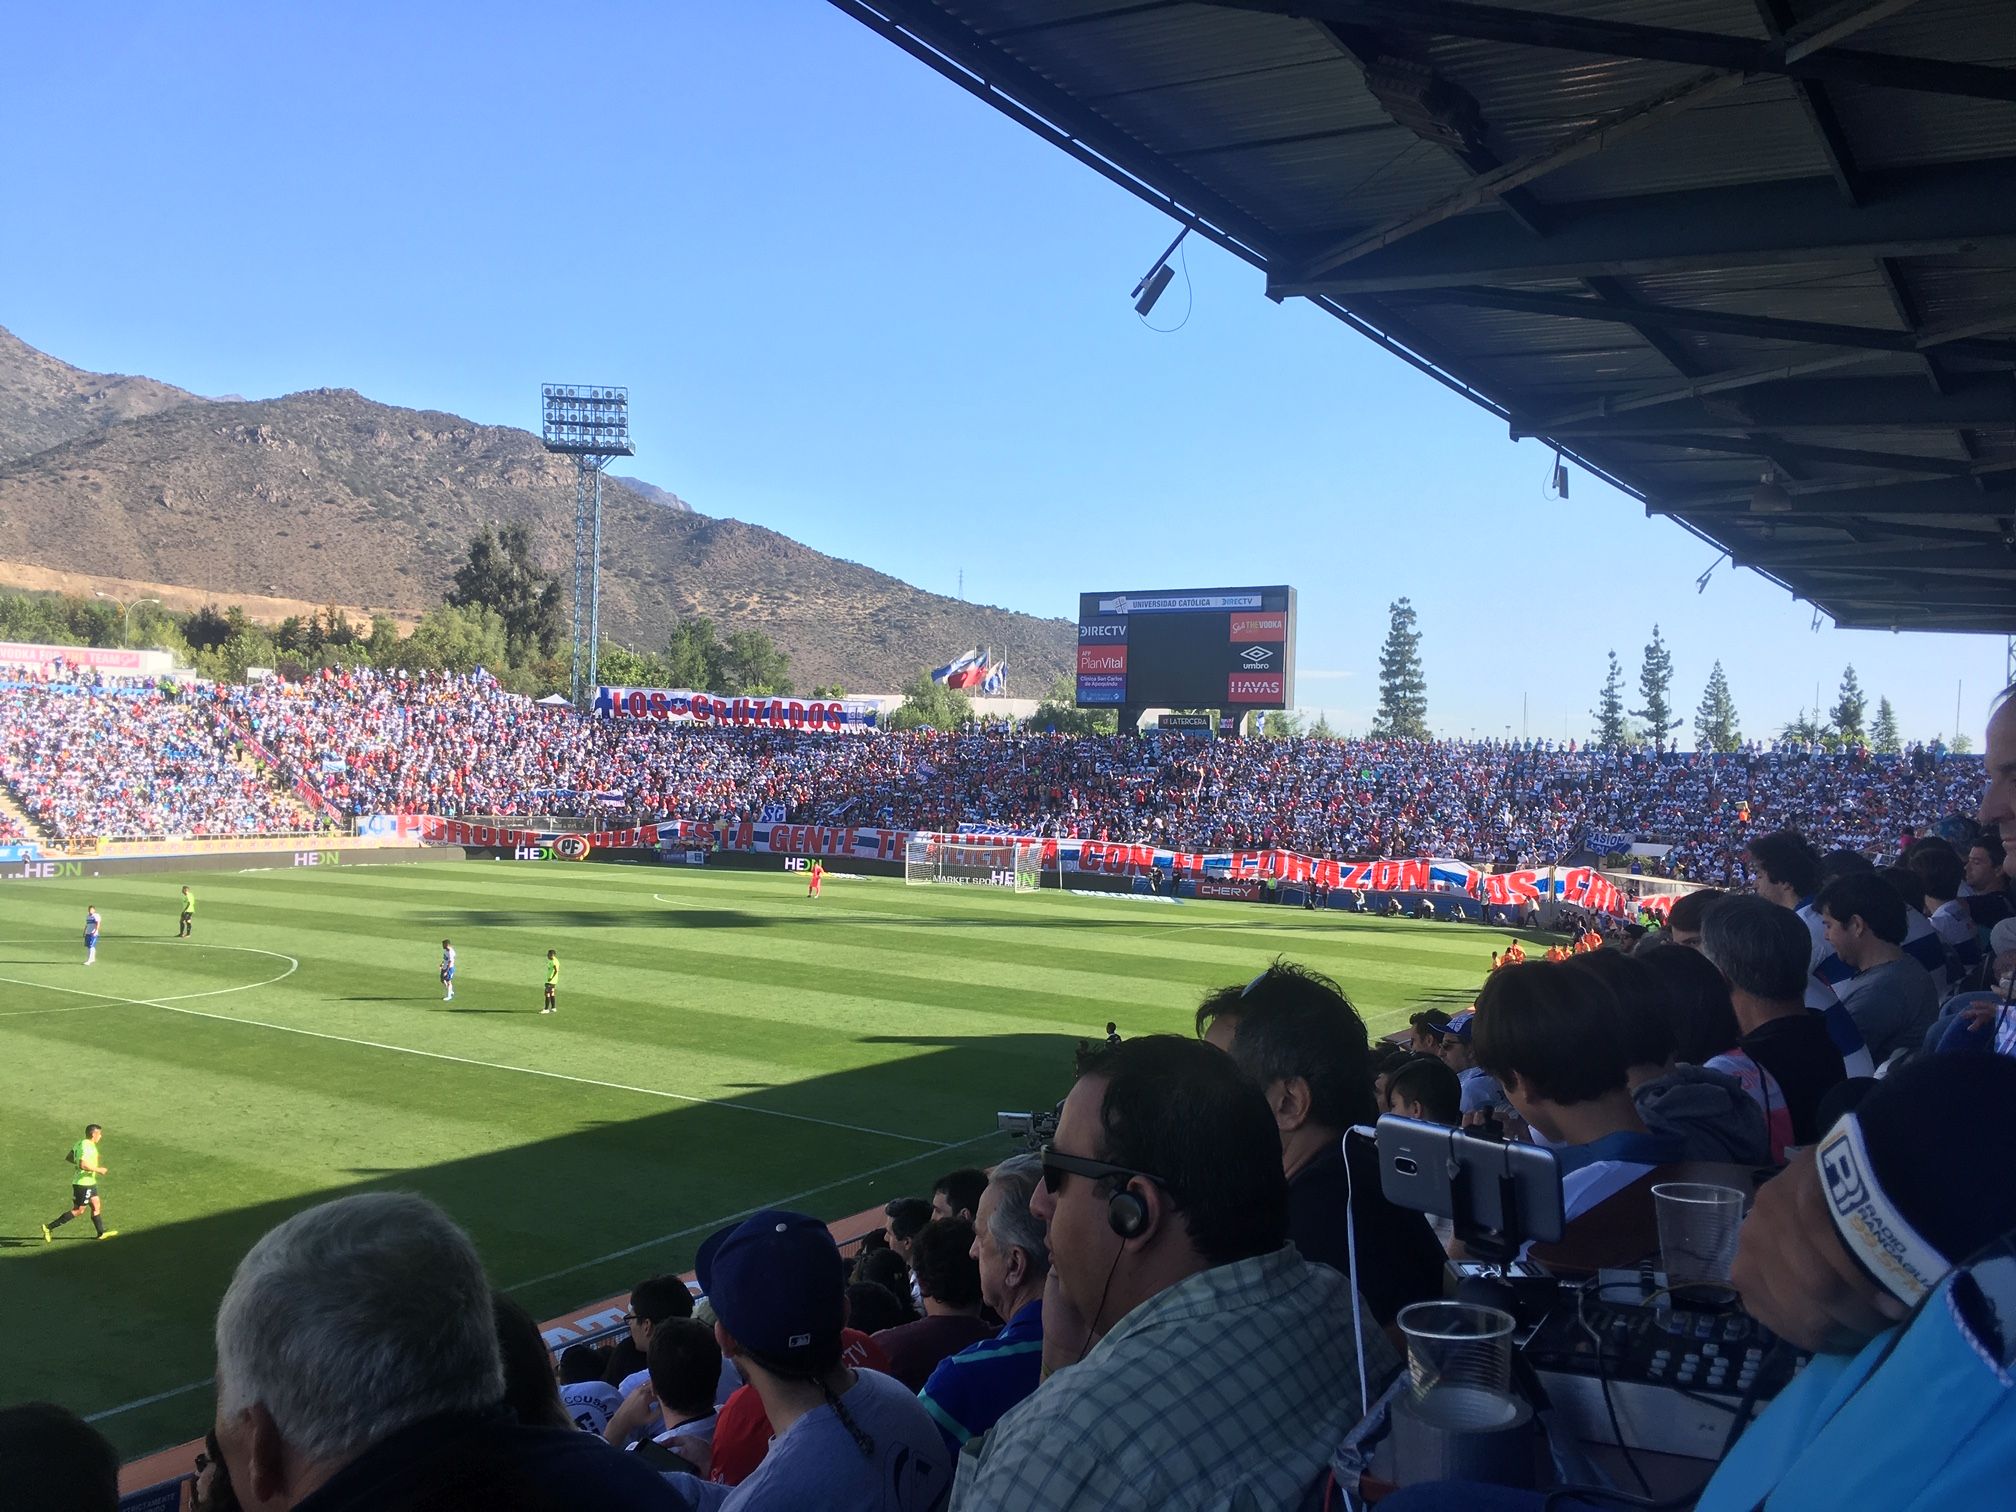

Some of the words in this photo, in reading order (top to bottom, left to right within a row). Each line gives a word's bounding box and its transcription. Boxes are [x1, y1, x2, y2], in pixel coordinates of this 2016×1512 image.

[1132, 600, 1177, 609] UNIVERSIDAD
[1079, 625, 1127, 637] DIRECTV
[90, 653, 120, 665] TEAM
[1081, 656, 1123, 669] PlanVital
[1243, 662, 1269, 670] umbro
[1231, 681, 1280, 694] HAVAS
[613, 691, 668, 721] LOS
[690, 695, 843, 731] CRUZADOS
[561, 839, 580, 854] PF
[768, 825, 859, 854] GENTE
[876, 830, 909, 860] TE
[1079, 840, 1155, 876] CON
[1466, 869, 1540, 905] LOS
[932, 875, 970, 886] MARKET
[1201, 885, 1251, 897] CHERY
[1864, 1203, 1907, 1253] RADIO
